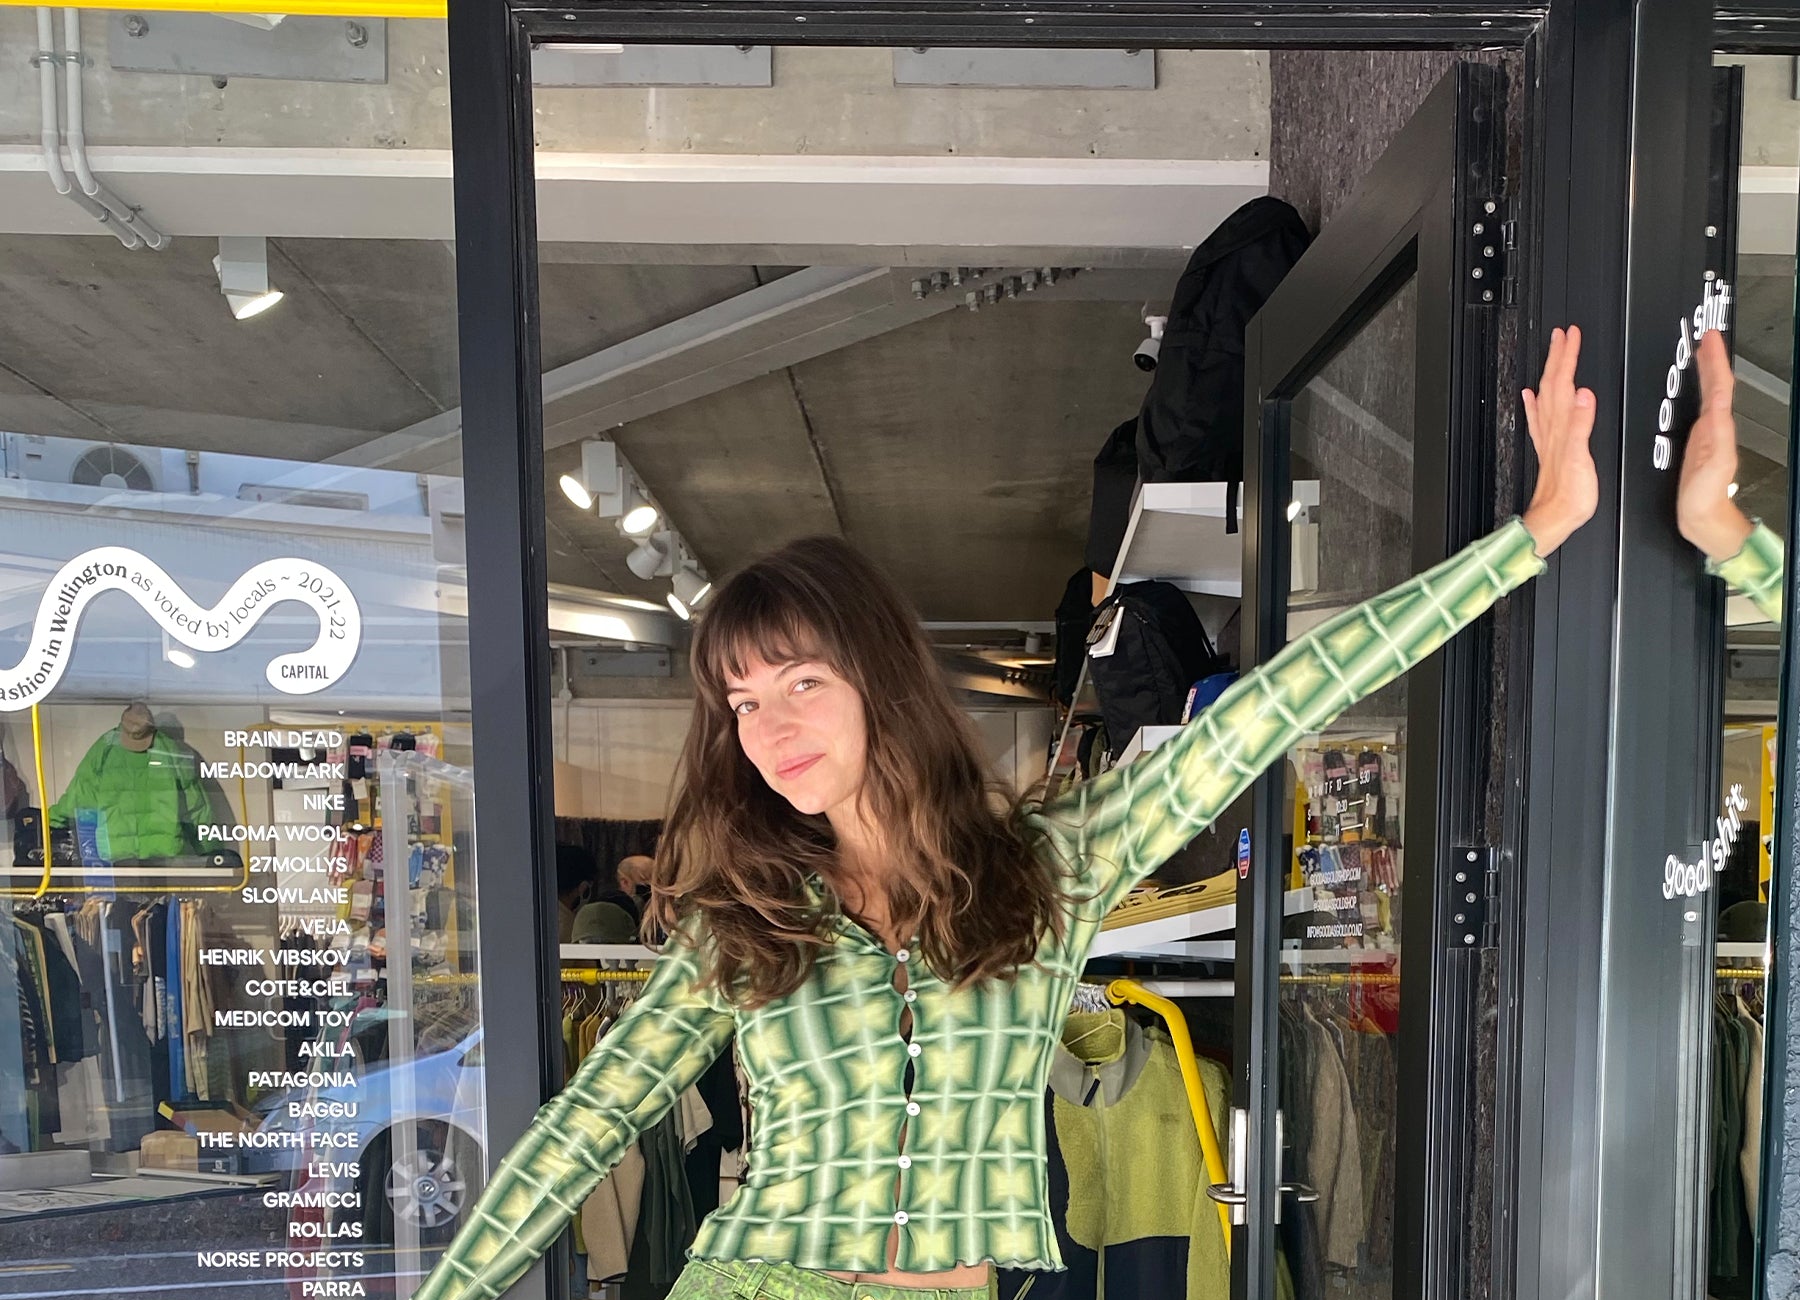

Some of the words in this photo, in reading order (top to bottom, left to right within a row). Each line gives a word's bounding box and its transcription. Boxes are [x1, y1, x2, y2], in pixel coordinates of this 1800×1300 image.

[130, 571, 153, 592] as
[49, 561, 127, 633] Wellington
[233, 576, 277, 626] locals
[298, 571, 346, 640] 2021-22
[154, 591, 201, 635] voted
[207, 621, 231, 639] by
[42, 639, 62, 658] in
[281, 665, 329, 680] CAPITAL
[224, 731, 282, 748] BRAIN
[288, 731, 342, 748] DEAD
[200, 762, 344, 779] MEADOWLARK
[303, 794, 344, 811] NIKE
[198, 825, 280, 842] PALOMA
[285, 825, 347, 842] WOOL
[1663, 840, 1711, 900] good
[1712, 783, 1748, 872] shit
[249, 856, 347, 873] 27MOLLYS
[242, 887, 348, 904] SLOWLANE
[300, 919, 350, 935] VEJA
[199, 949, 265, 966] HENRIK
[270, 949, 351, 966] VIBSKOV
[245, 980, 353, 997] COTE&CIEL
[215, 1010, 310, 1027] MEDICOM
[315, 1010, 352, 1027] TOY
[298, 1041, 355, 1057] AKILA
[248, 1071, 357, 1088] PATAGONIA
[289, 1101, 357, 1118] BAGGU
[198, 1132, 233, 1148] THE
[239, 1132, 304, 1148] NORTH
[310, 1132, 359, 1148] FACE
[308, 1162, 360, 1178] LEVIS
[263, 1191, 361, 1208] GRAMICCI
[289, 1221, 363, 1238] ROLLAS
[197, 1251, 260, 1268] NORSE
[266, 1251, 364, 1268] PROJECTS
[302, 1281, 365, 1297] PARRA
